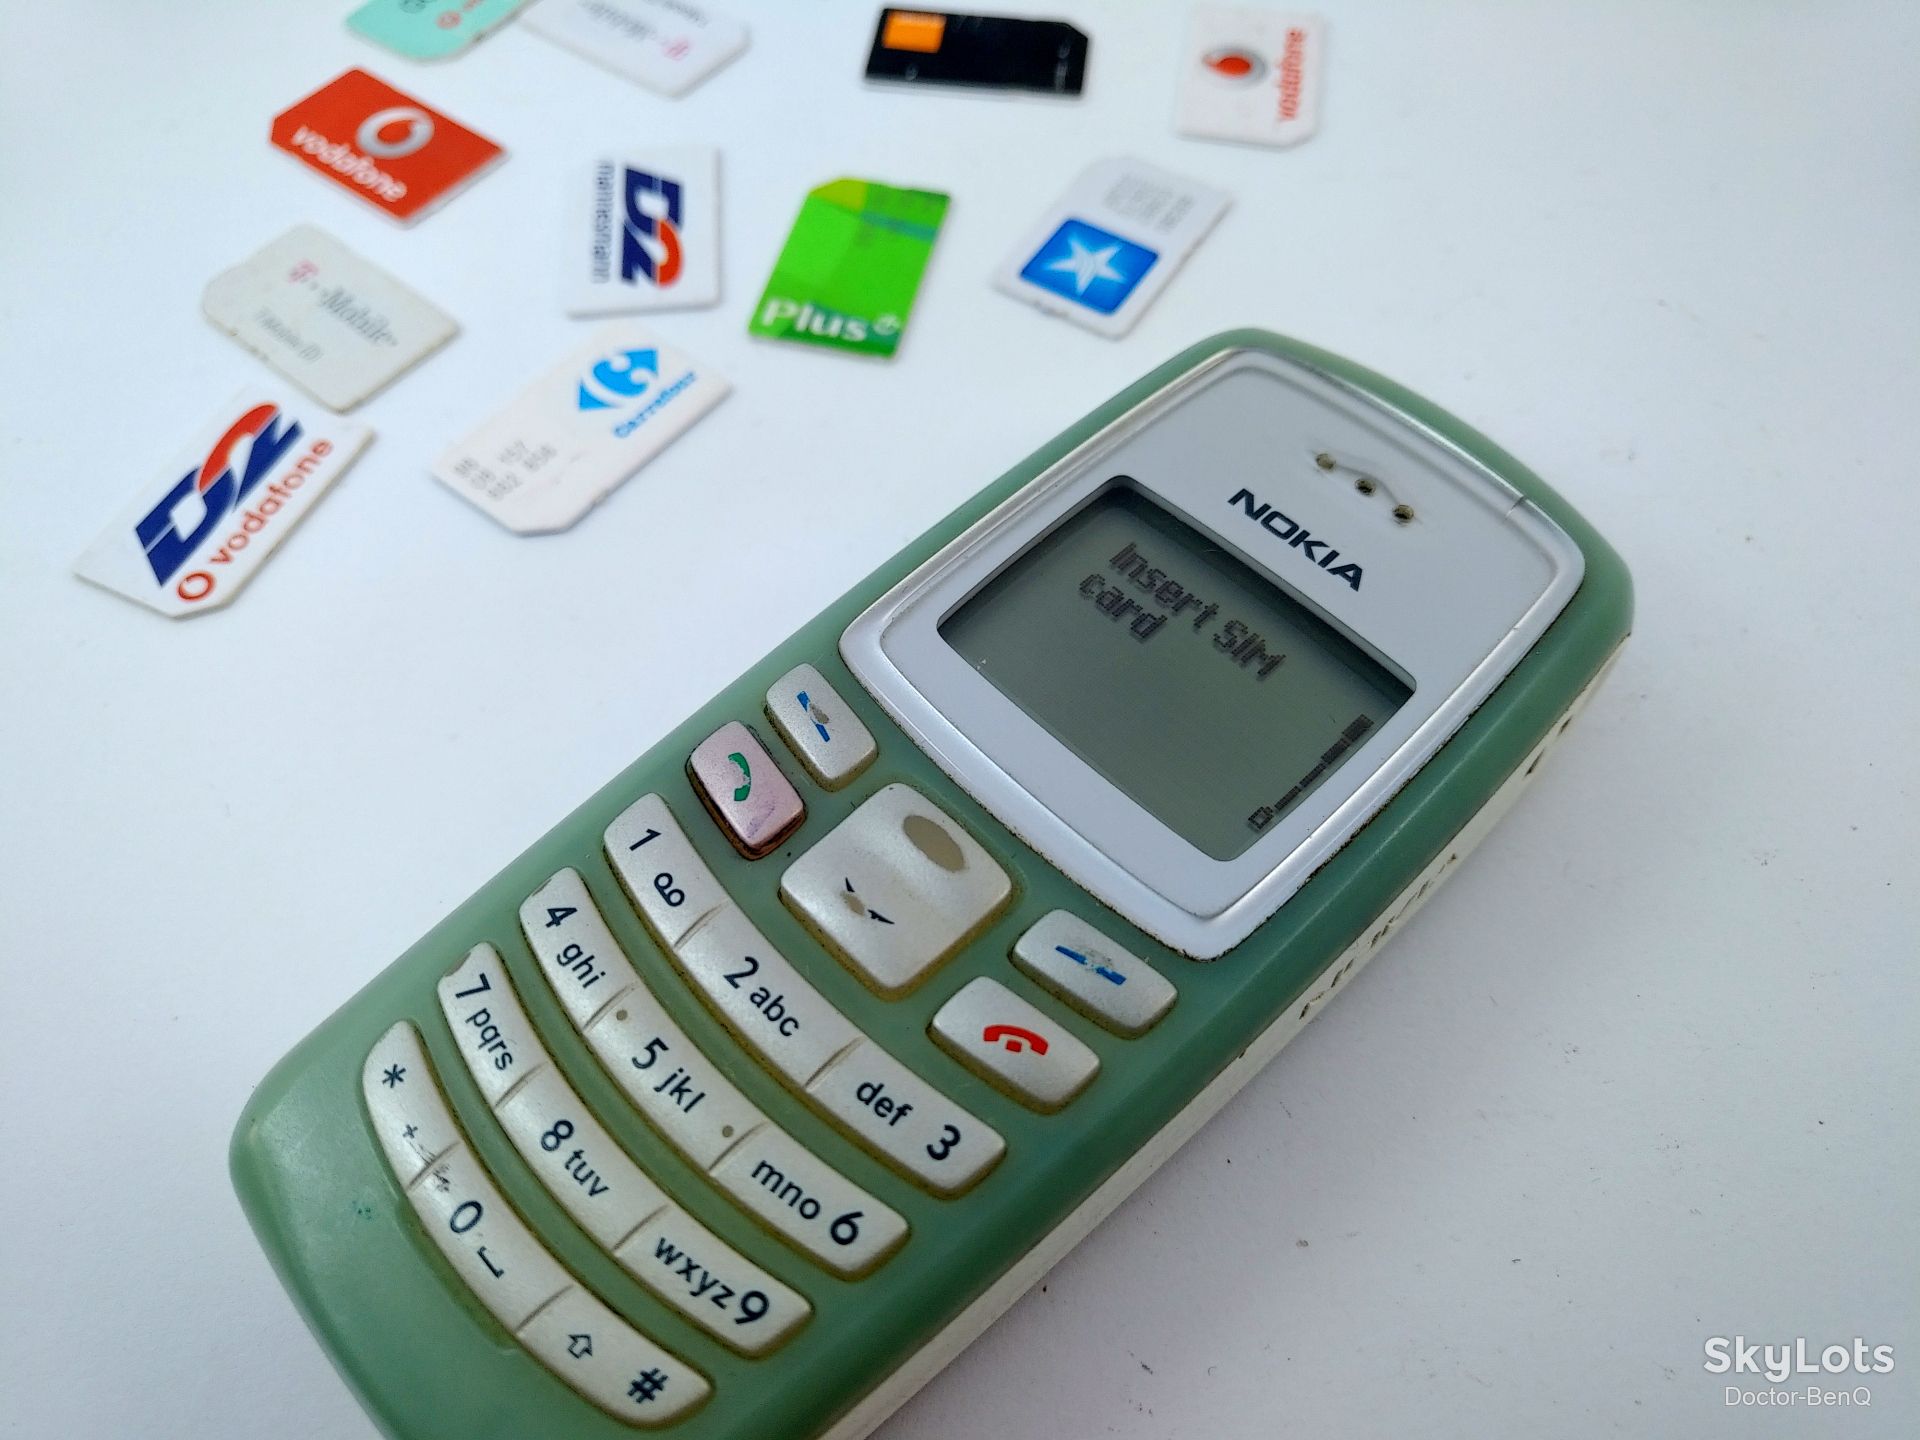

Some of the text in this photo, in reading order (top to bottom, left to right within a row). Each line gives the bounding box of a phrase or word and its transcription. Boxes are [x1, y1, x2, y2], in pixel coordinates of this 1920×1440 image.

[1275, 27, 1305, 122] vodafone
[291, 125, 408, 203] vodafone
[760, 299, 868, 343] Plus
[134, 402, 304, 588] D2
[208, 437, 334, 567] vodafone
[1227, 487, 1364, 593] NOKIA
[1079, 573, 1168, 640] card
[1109, 541, 1287, 678] Insert SIM
[629, 827, 663, 852] 1
[545, 905, 606, 989] 4 ghi
[455, 972, 513, 1071] 7 pqrs
[723, 956, 800, 1038] 2 abc
[631, 1036, 706, 1114] 5 jkl
[540, 1119, 610, 1198] 8 tuv
[856, 1080, 962, 1162] def 3
[449, 1199, 484, 1234] 0
[750, 1159, 865, 1246] mno 6
[653, 1236, 771, 1326] wxyz 9
[627, 1366, 669, 1404] #
